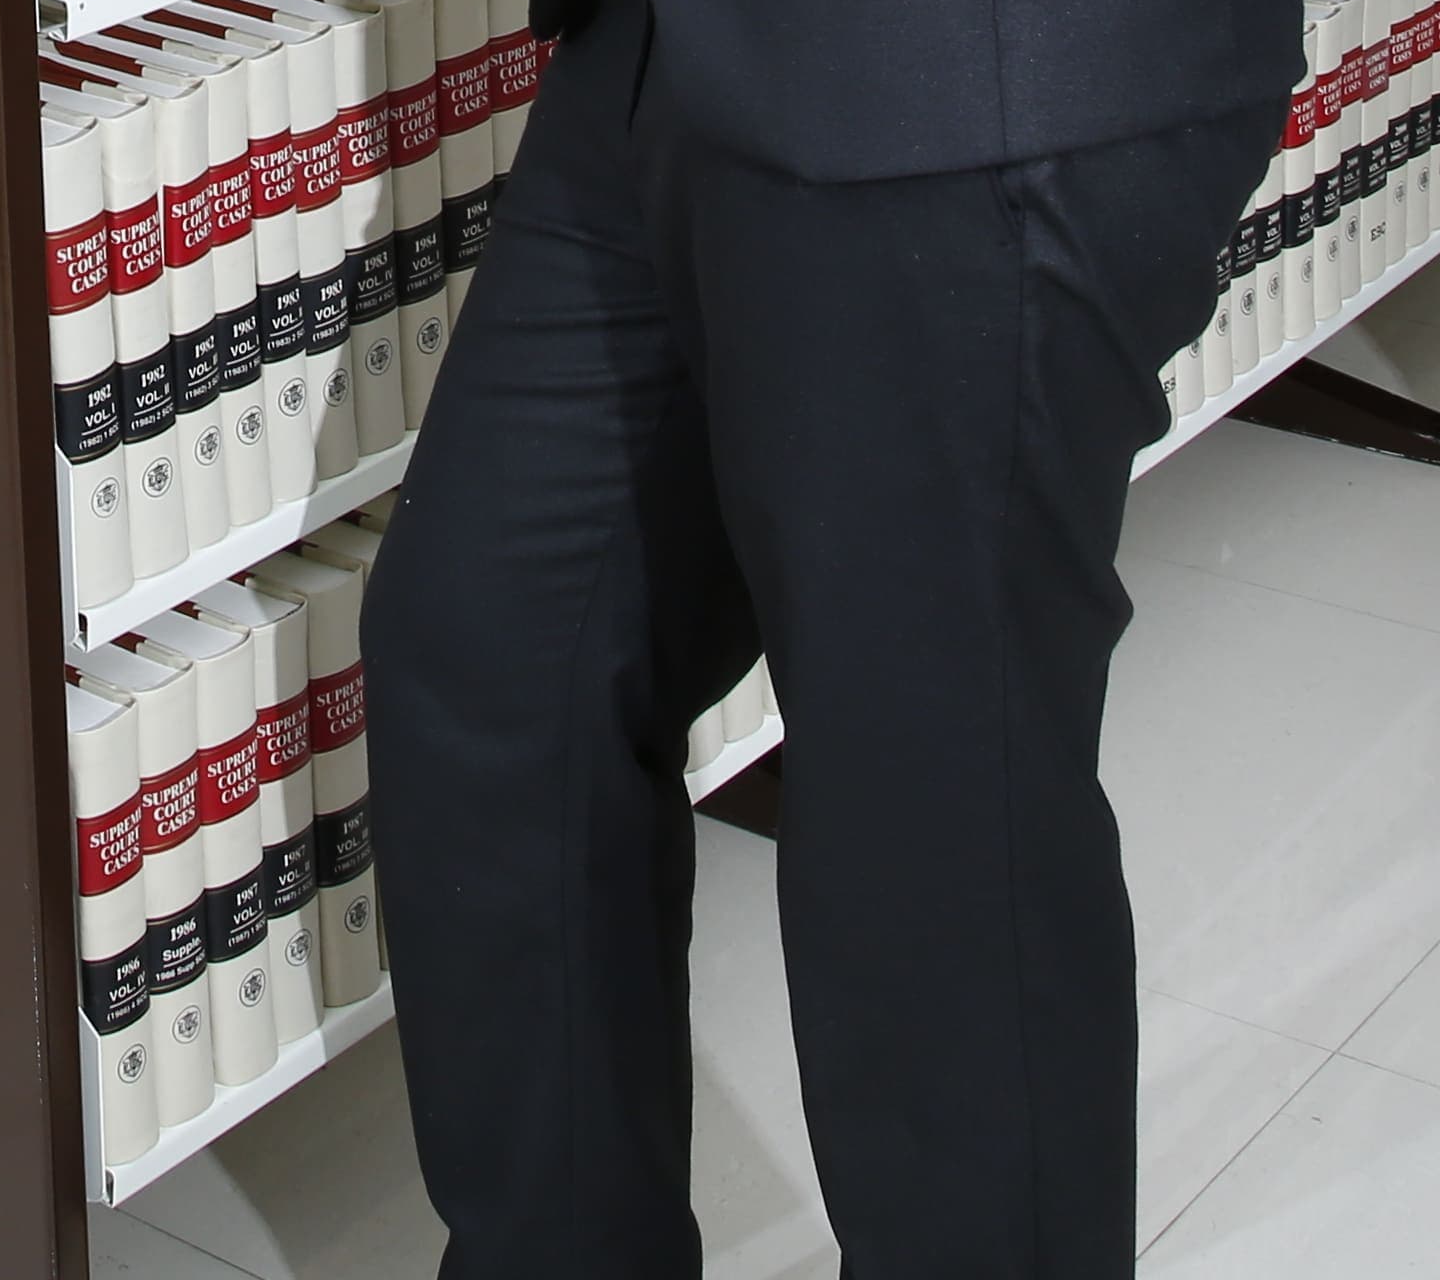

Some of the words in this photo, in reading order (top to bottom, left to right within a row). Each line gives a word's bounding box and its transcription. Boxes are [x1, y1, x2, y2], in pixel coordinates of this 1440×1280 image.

[87, 384, 111, 408] 1982
[85, 408, 111, 428] VOL.
[153, 788, 195, 821] COURT
[157, 806, 195, 836] CASES
[236, 882, 258, 906] 1987
[171, 917, 196, 941] 1986
